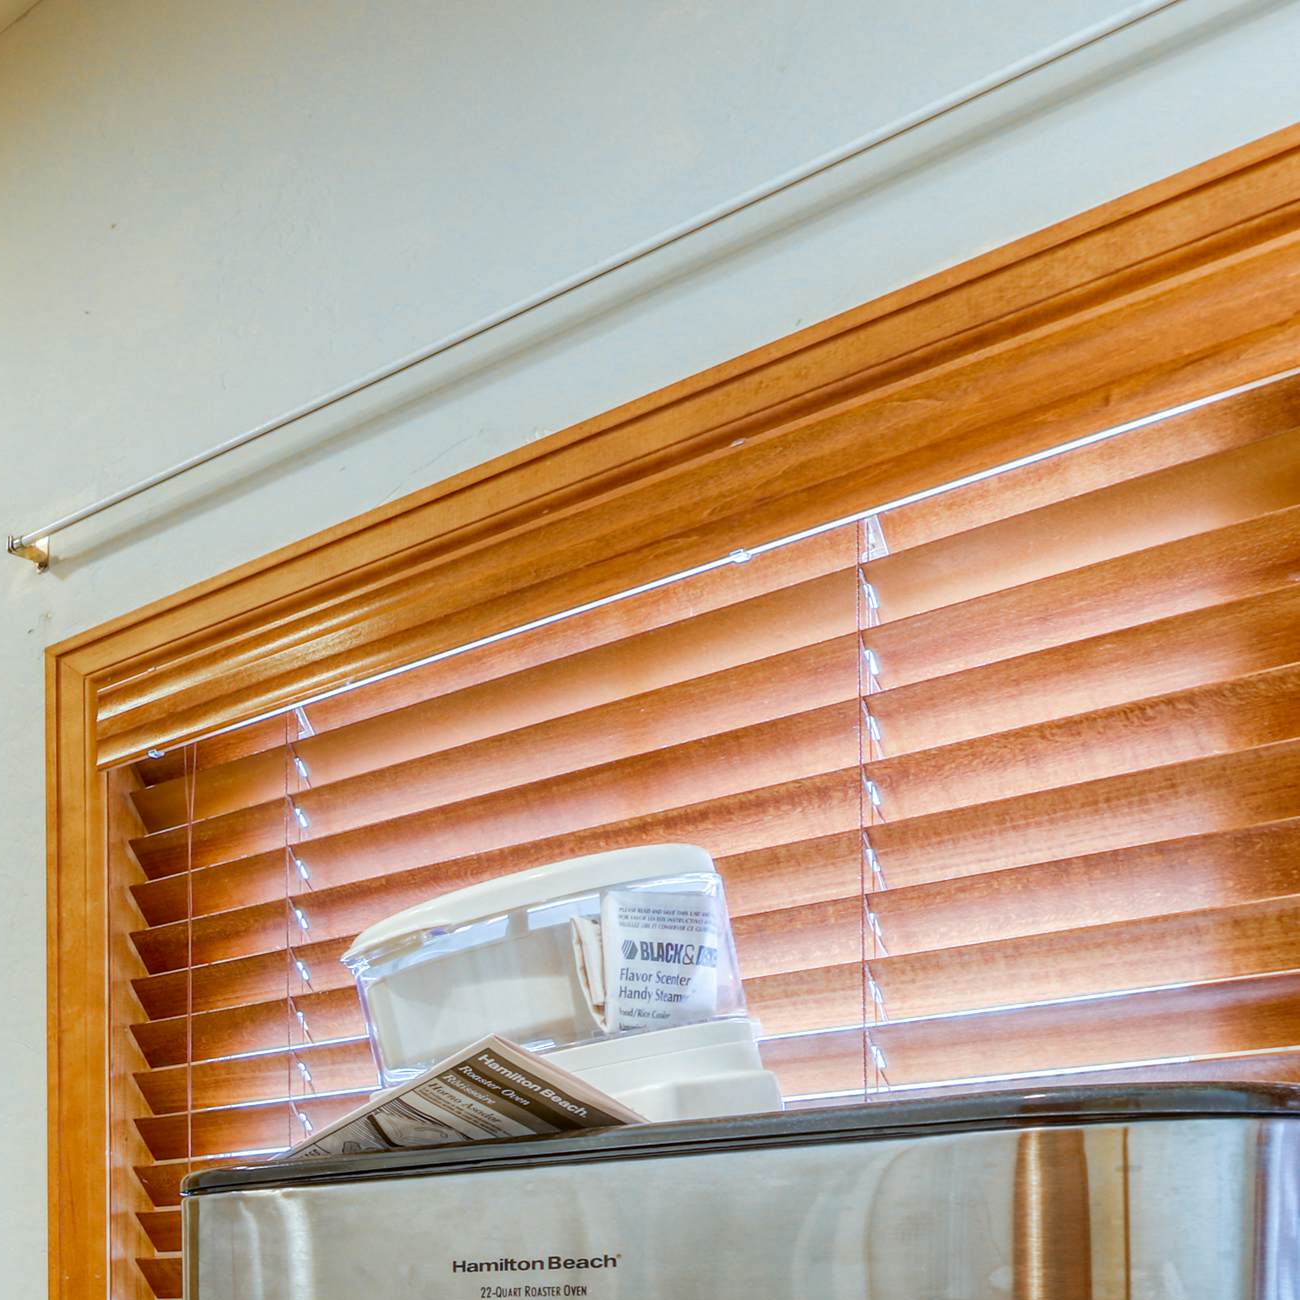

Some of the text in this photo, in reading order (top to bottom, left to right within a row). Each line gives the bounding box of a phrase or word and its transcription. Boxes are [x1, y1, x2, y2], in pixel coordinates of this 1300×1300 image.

[620, 968, 692, 986] Flavor Scenter
[619, 986, 654, 1001] Handy
[478, 1053, 542, 1093] Hamilton
[458, 1065, 530, 1106] Roaster Oven
[452, 1254, 617, 1274] Hamilton Beach
[480, 1284, 587, 1299] 22-QUART ROASTER OVEN
